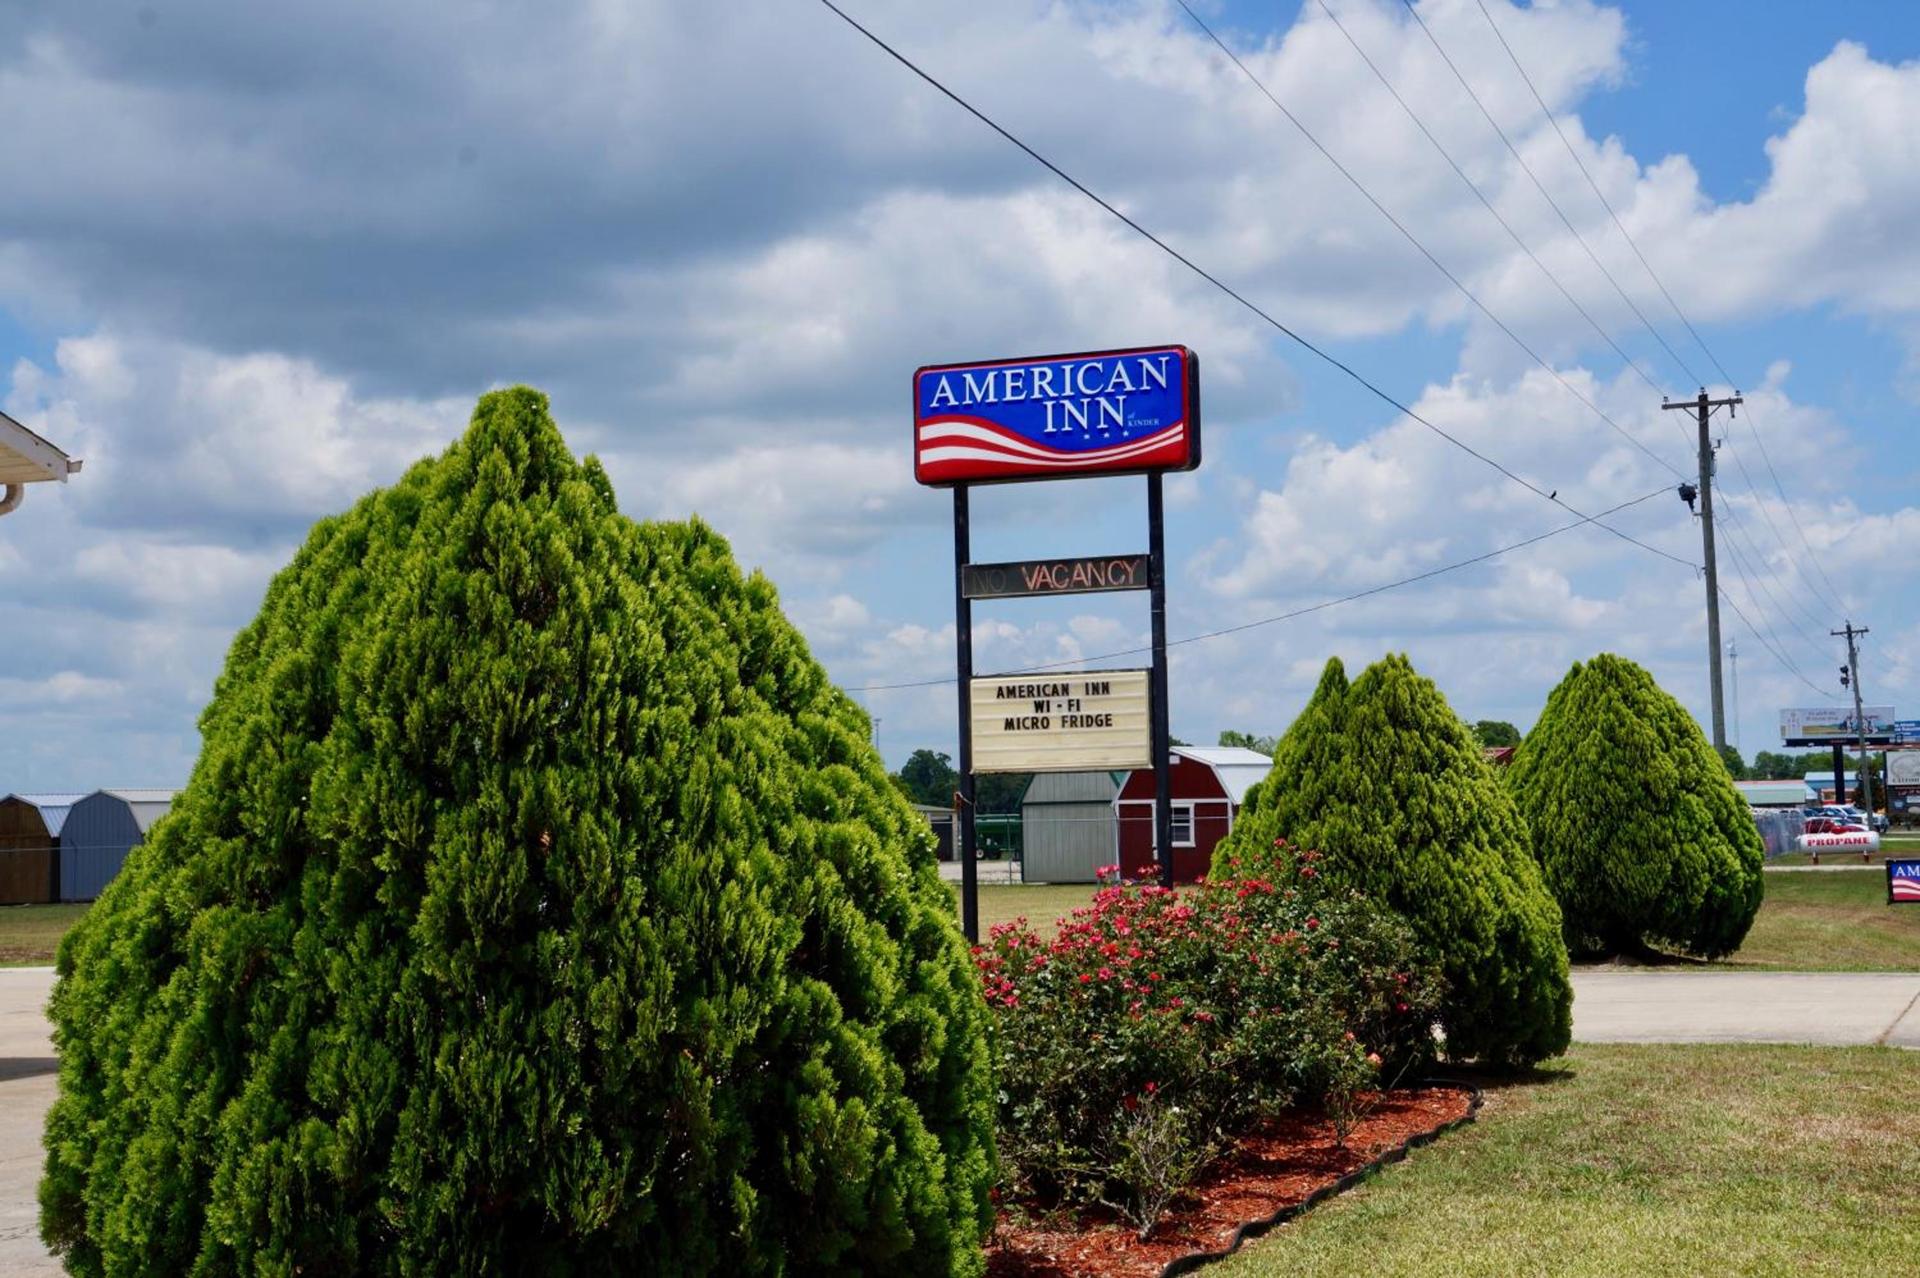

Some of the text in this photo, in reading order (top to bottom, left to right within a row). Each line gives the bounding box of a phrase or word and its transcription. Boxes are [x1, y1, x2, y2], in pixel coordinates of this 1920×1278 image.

[930, 356, 1169, 408] AMERICAN
[1043, 395, 1127, 433] INN
[1128, 418, 1160, 428] KINDER
[972, 559, 1139, 593] NO VACANCY
[996, 682, 1110, 699] AMERICAN INN
[1004, 713, 1113, 731] MICRO FRIDGE
[1807, 836, 1871, 847] PROPANE
